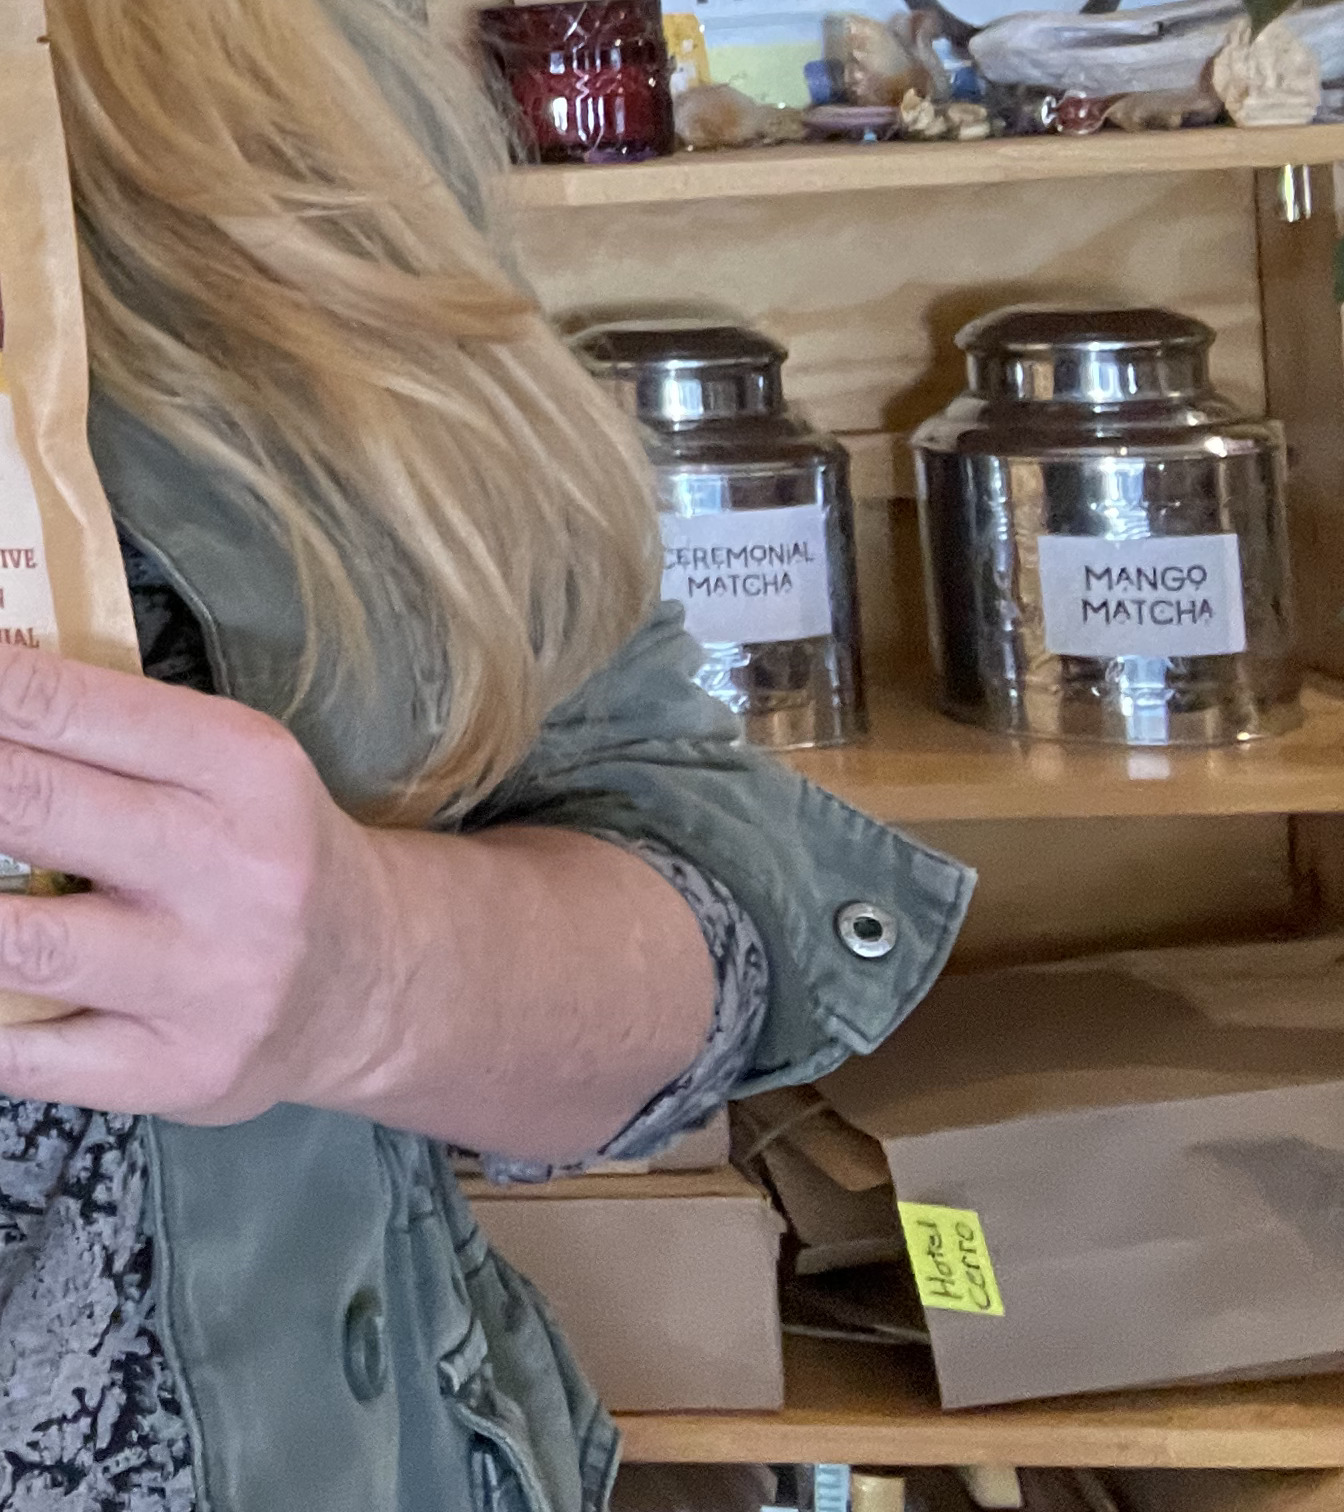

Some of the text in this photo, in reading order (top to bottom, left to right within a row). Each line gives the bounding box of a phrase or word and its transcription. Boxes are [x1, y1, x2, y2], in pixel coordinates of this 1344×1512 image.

[662, 541, 815, 571] CEREMONIAL
[688, 572, 792, 597] MATCHA
[1084, 565, 1208, 591] MANGO
[1081, 598, 1214, 625] MATCHA
[916, 1219, 963, 1300] Hotel
